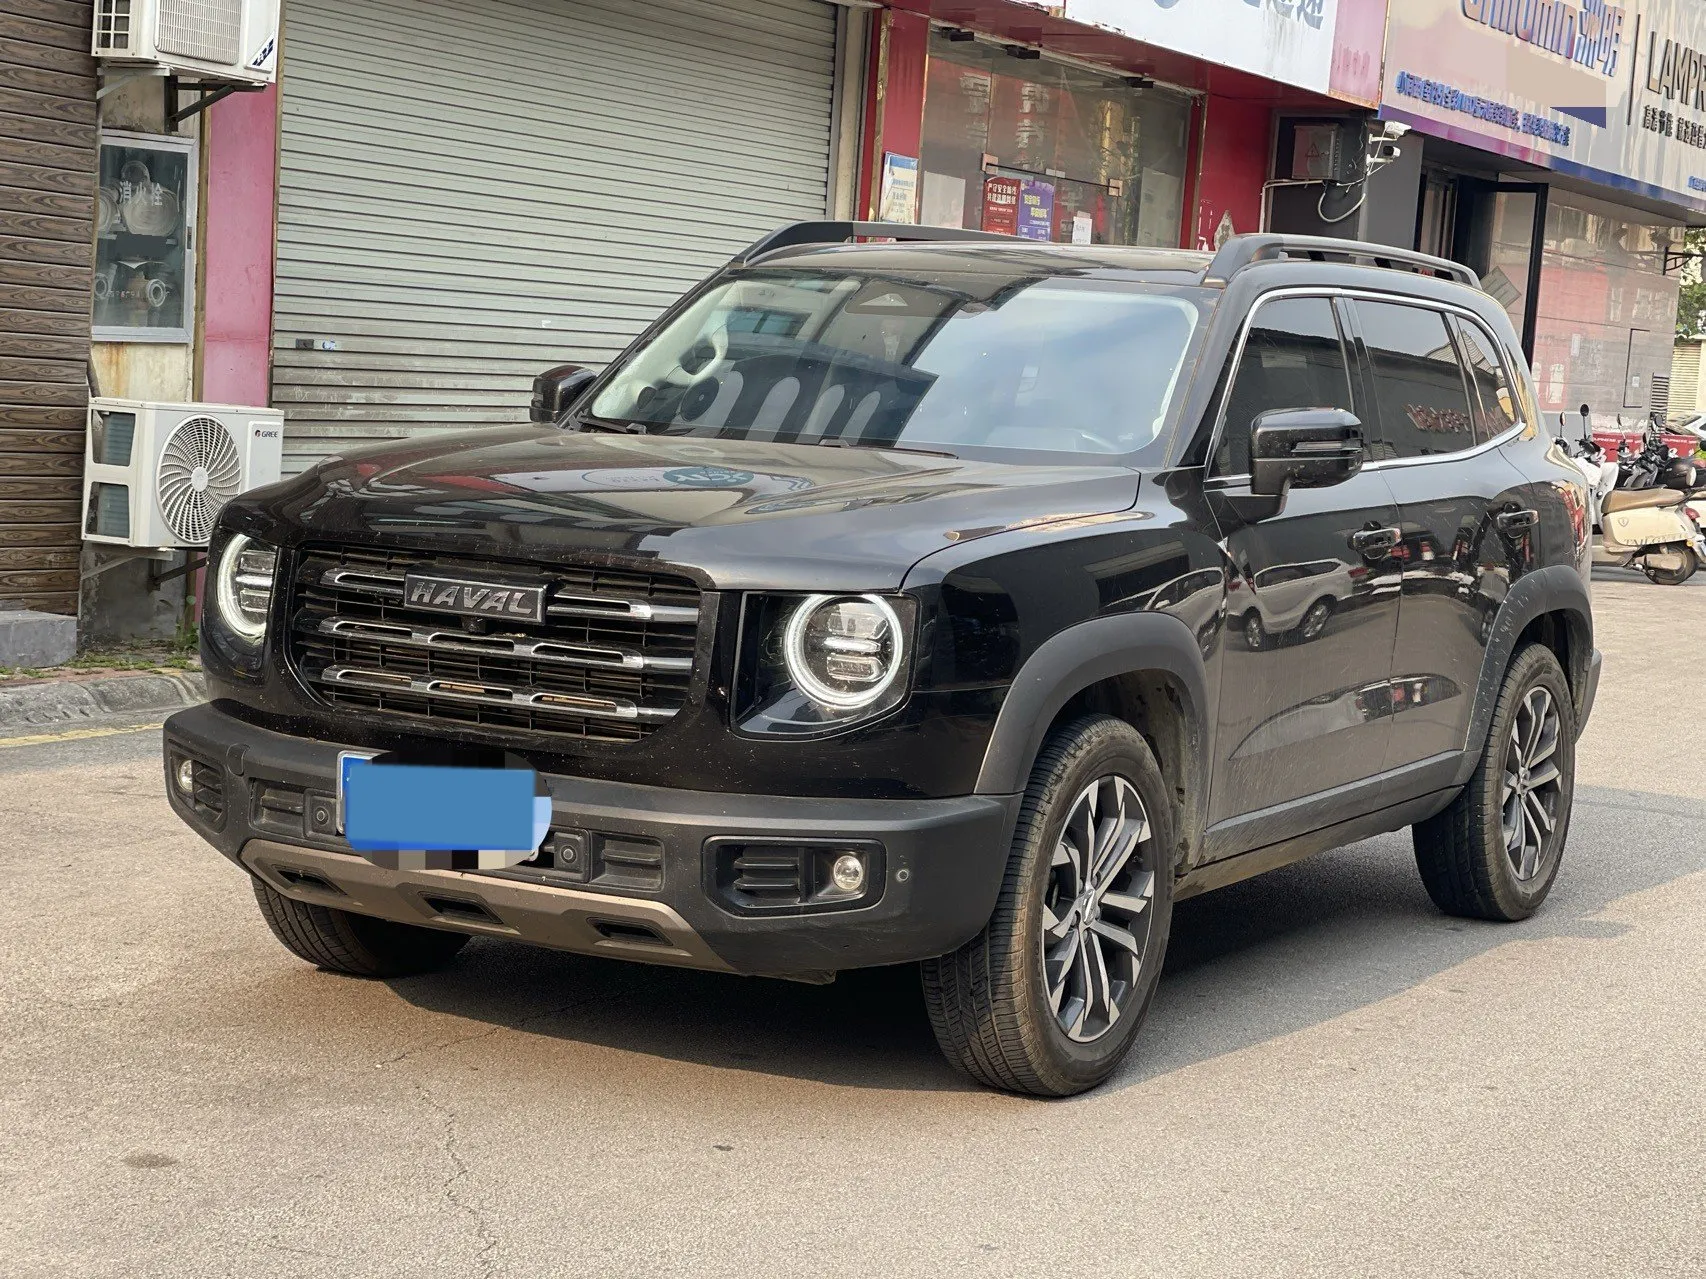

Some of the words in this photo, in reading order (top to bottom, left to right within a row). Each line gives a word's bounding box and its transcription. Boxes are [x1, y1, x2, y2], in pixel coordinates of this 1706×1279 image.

[119, 179, 163, 207] 消火栓
[261, 430, 278, 438] GREE
[410, 581, 532, 614] HAVAL
